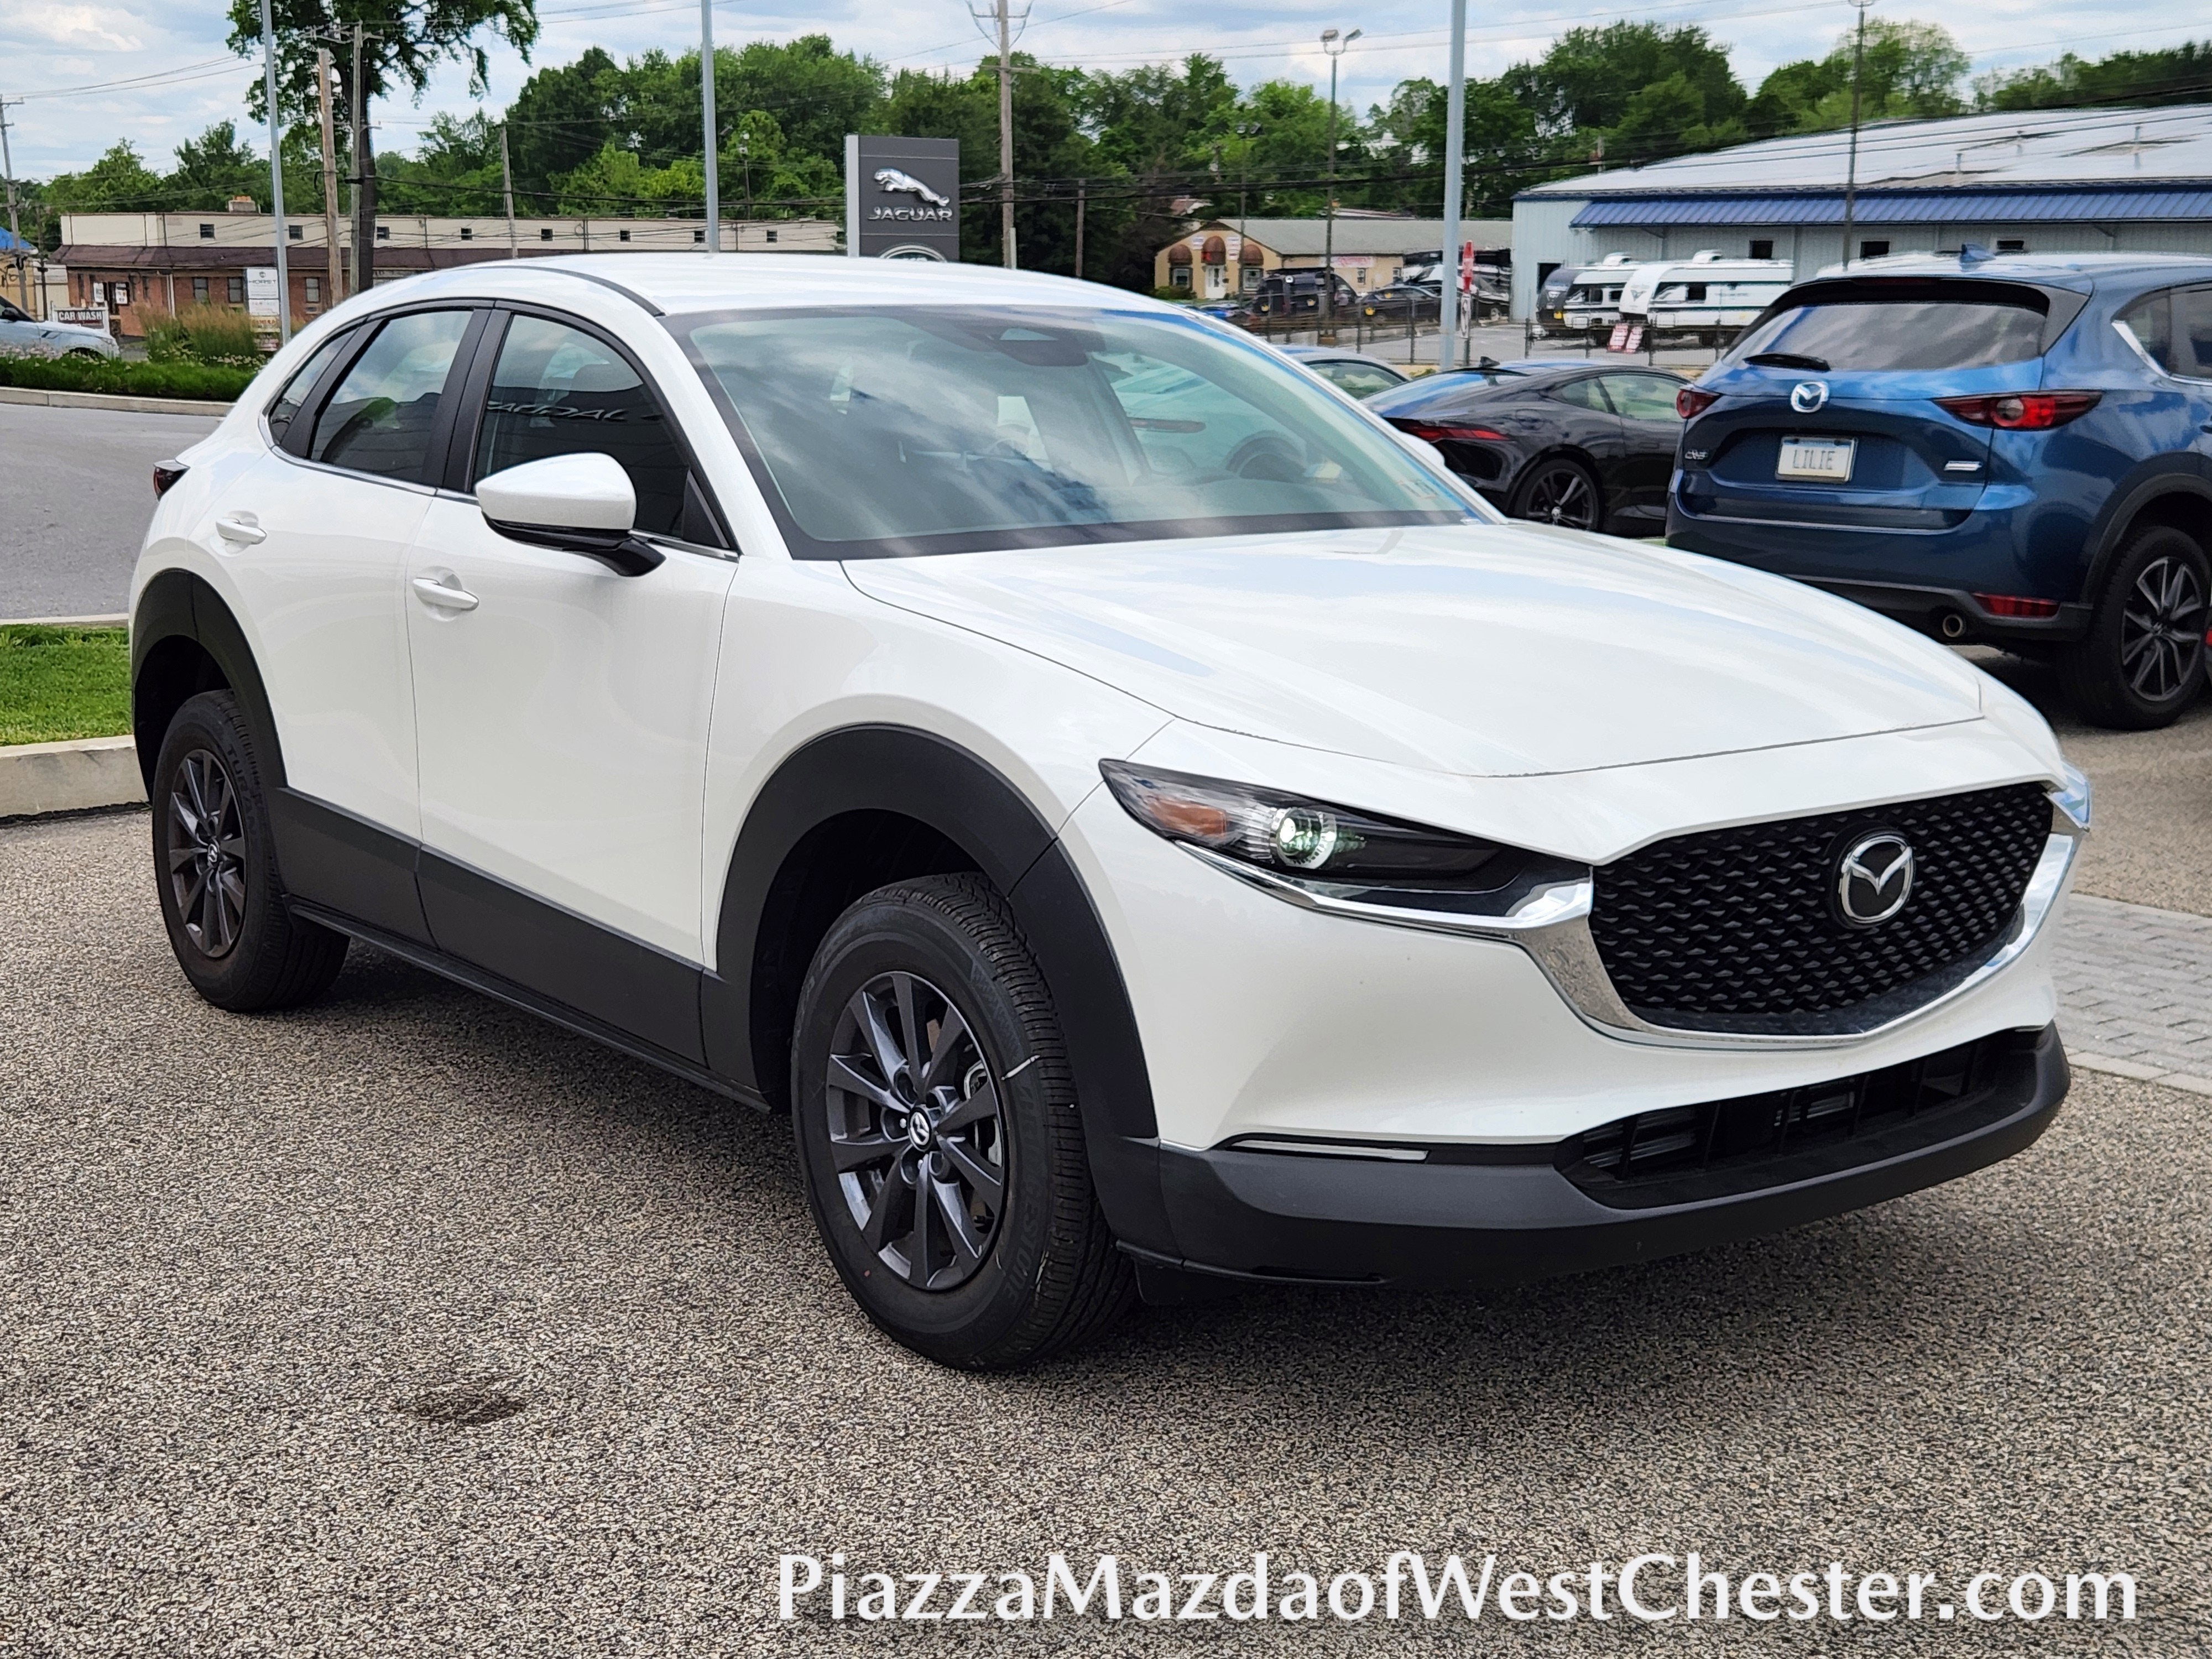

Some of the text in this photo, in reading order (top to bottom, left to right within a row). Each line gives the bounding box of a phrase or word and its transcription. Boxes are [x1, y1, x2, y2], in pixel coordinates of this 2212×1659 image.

[868, 206, 953, 221] JAGUAR
[59, 311, 102, 321] CAR WASH
[1792, 450, 1835, 470] LILIE
